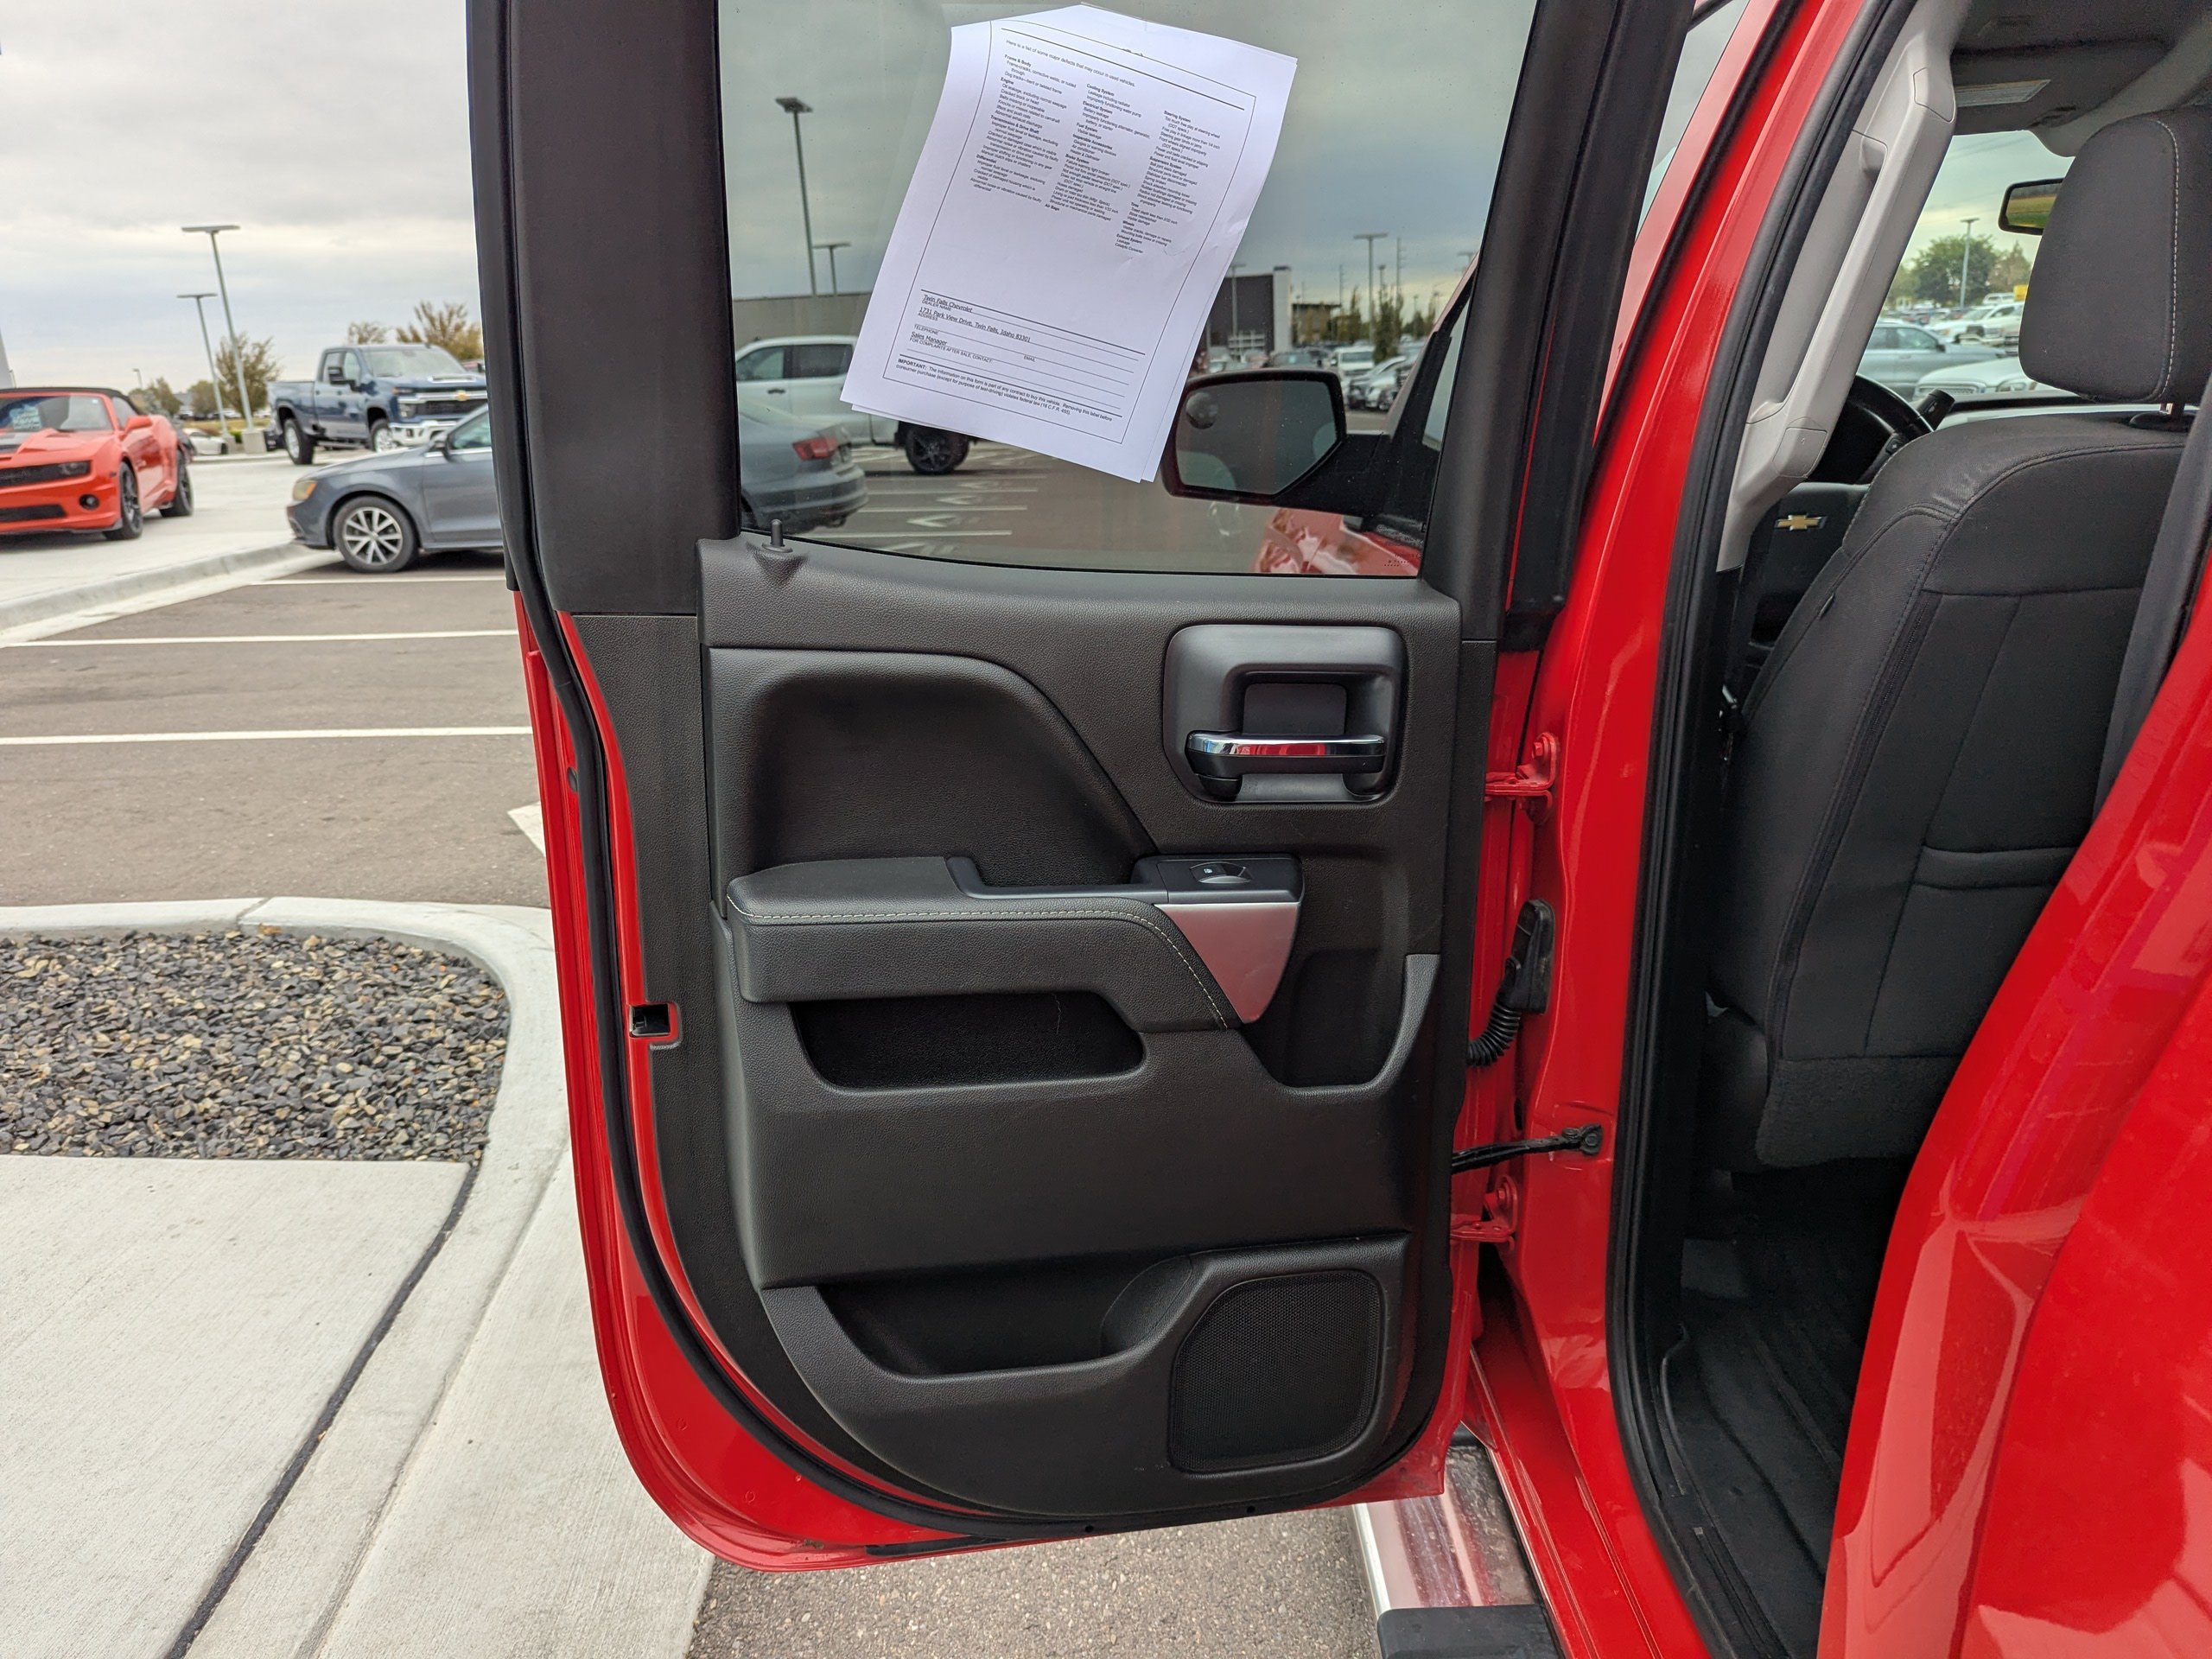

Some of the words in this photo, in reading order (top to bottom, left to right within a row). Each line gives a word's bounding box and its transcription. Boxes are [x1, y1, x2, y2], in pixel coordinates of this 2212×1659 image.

[948, 301, 973, 313] Chevrolet
[918, 312, 938, 321] ADDRESS
[925, 335, 948, 346] Manager
[999, 329, 1014, 338] Idaho
[1014, 334, 1031, 342] 83301
[919, 340, 946, 350] COMPLAINTS
[938, 368, 960, 378] information
[1062, 404, 1083, 413] Removing
